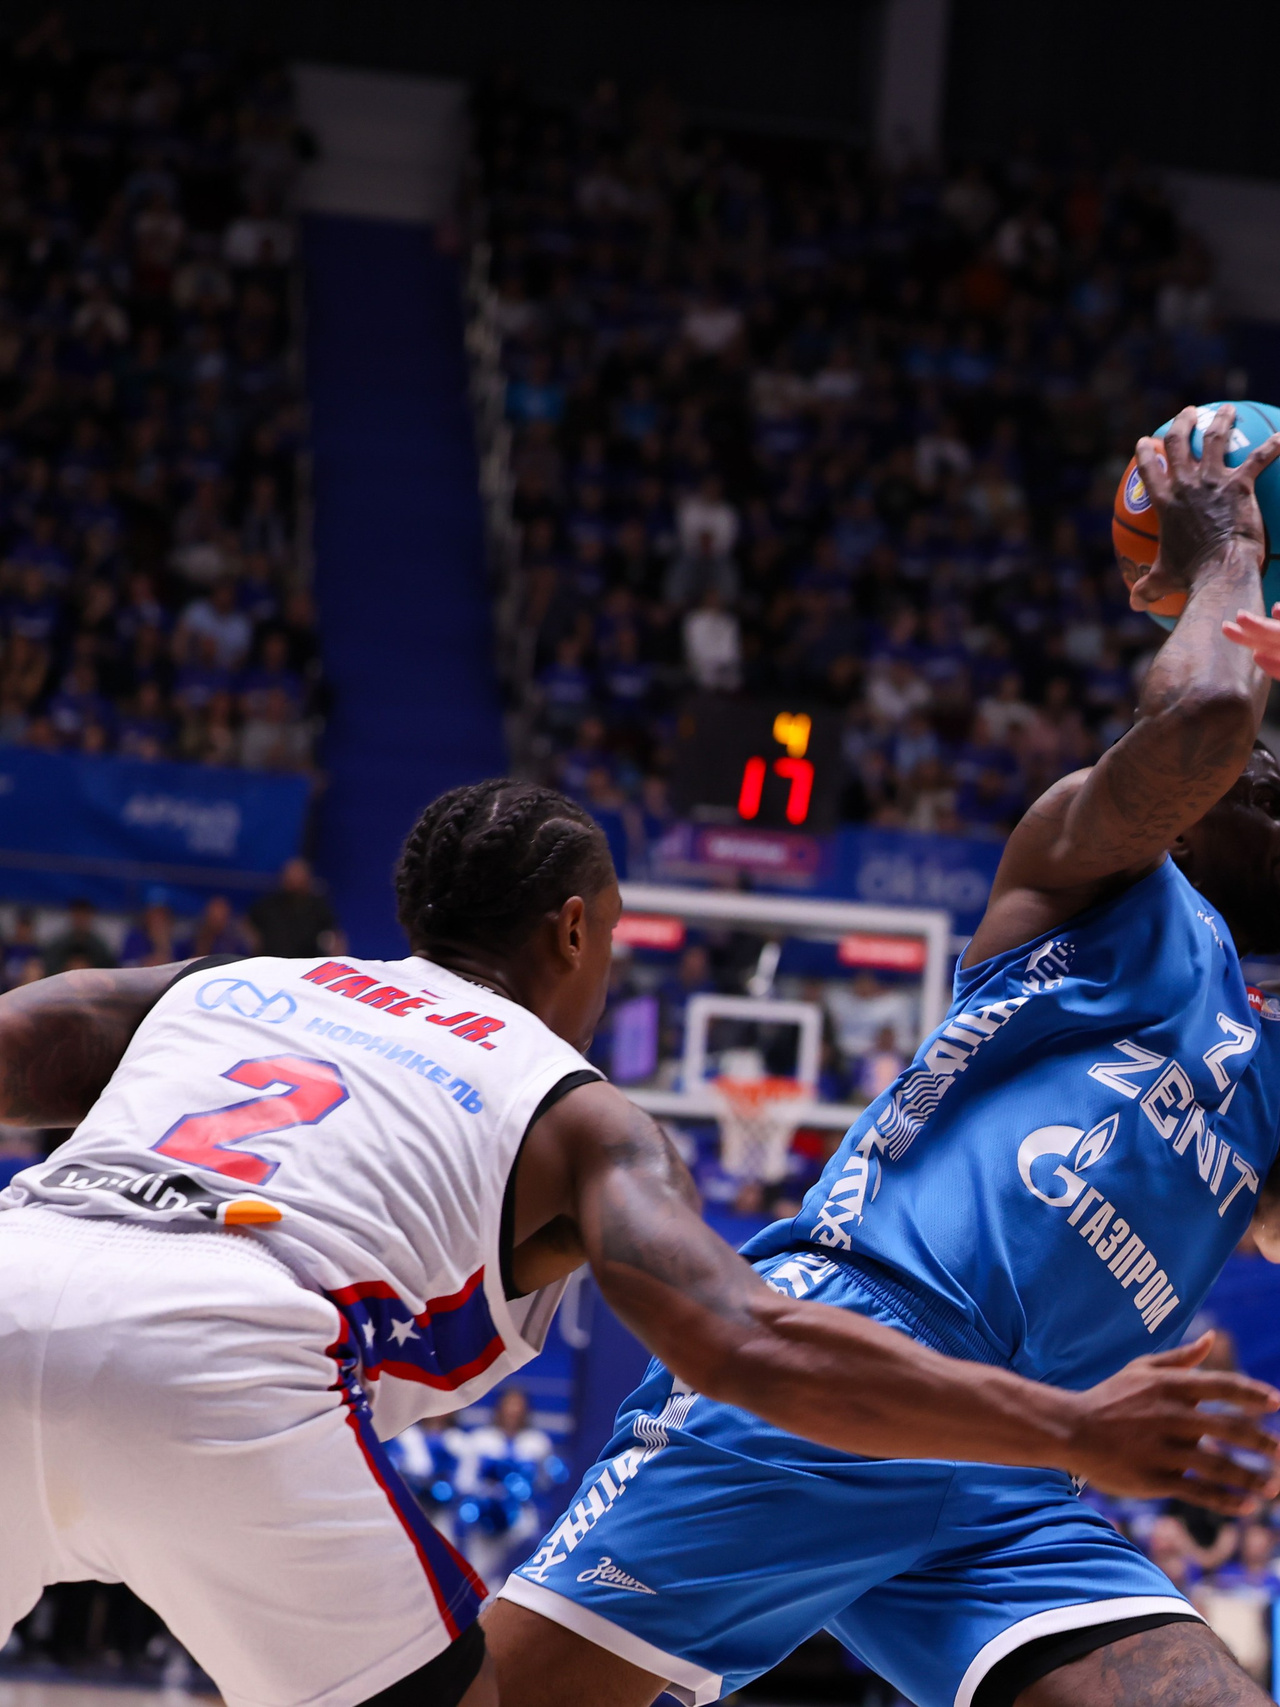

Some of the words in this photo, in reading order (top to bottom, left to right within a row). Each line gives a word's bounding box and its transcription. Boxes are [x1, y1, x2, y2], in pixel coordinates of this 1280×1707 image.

[738, 756, 814, 825] 17
[300, 960, 438, 1017] WARE
[425, 1011, 506, 1050] JR.
[304, 1017, 484, 1114] НОРНИКЕЛЬ
[151, 1052, 350, 1186] 2
[1087, 1039, 1259, 1218] ZENIT
[1067, 1186, 1180, 1334] ГАЗПРОМ
[577, 1556, 657, 1595] Зенит
